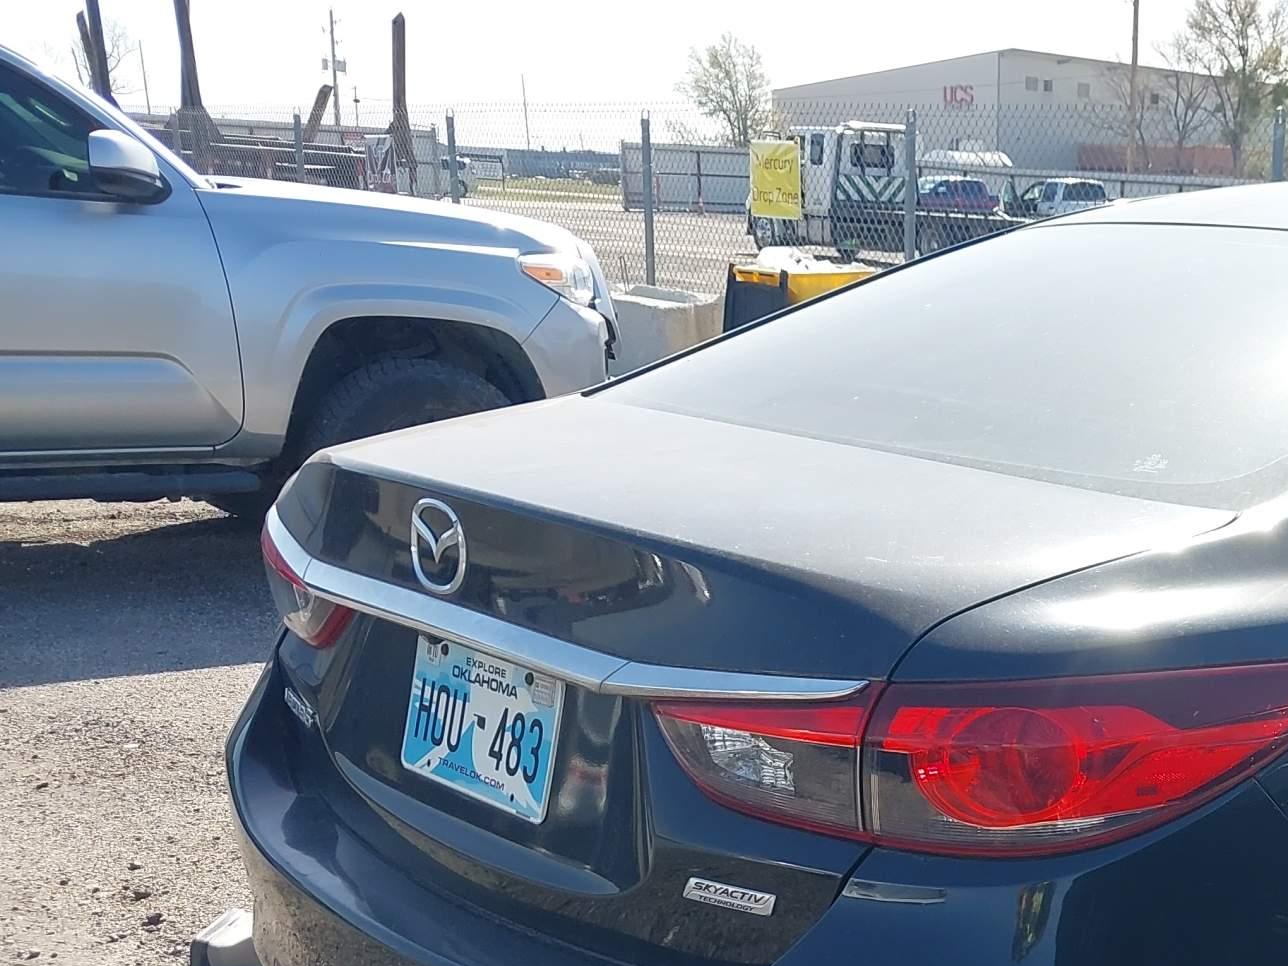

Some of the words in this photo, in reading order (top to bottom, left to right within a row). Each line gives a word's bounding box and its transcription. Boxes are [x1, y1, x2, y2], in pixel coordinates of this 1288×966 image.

[943, 84, 974, 105] UCS
[756, 154, 793, 174] Mercury
[752, 186, 773, 206] Drop
[776, 187, 799, 205] Zone
[466, 656, 507, 678] EXPLORE
[452, 665, 518, 699] OKLAHOMA
[438, 757, 505, 791] TRAVELOK.COM
[692, 881, 765, 903] SKYACTIV
[699, 895, 754, 911] TECHNOLOGY
